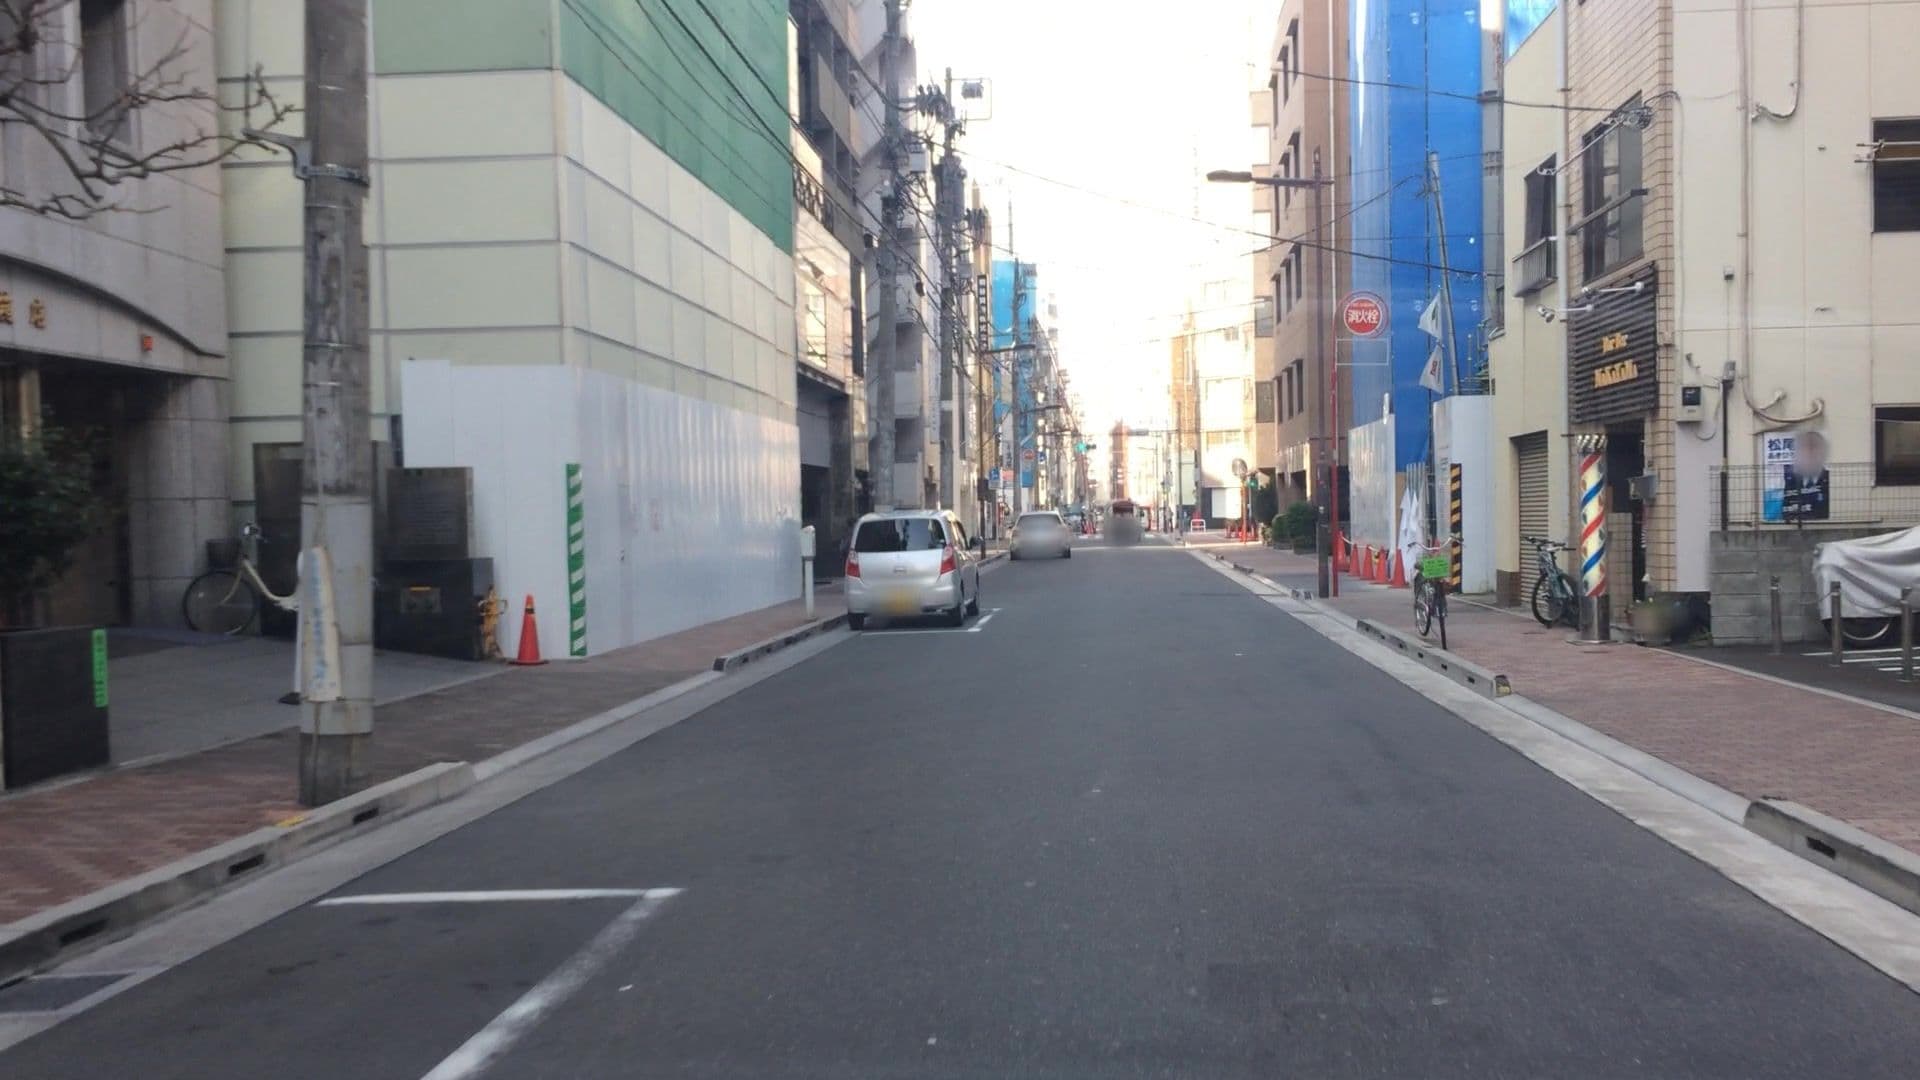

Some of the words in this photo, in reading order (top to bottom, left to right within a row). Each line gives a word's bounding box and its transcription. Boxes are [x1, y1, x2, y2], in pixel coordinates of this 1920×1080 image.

[1347, 309, 1378, 324] 消火栓
[1768, 438, 1795, 451] 松尾
